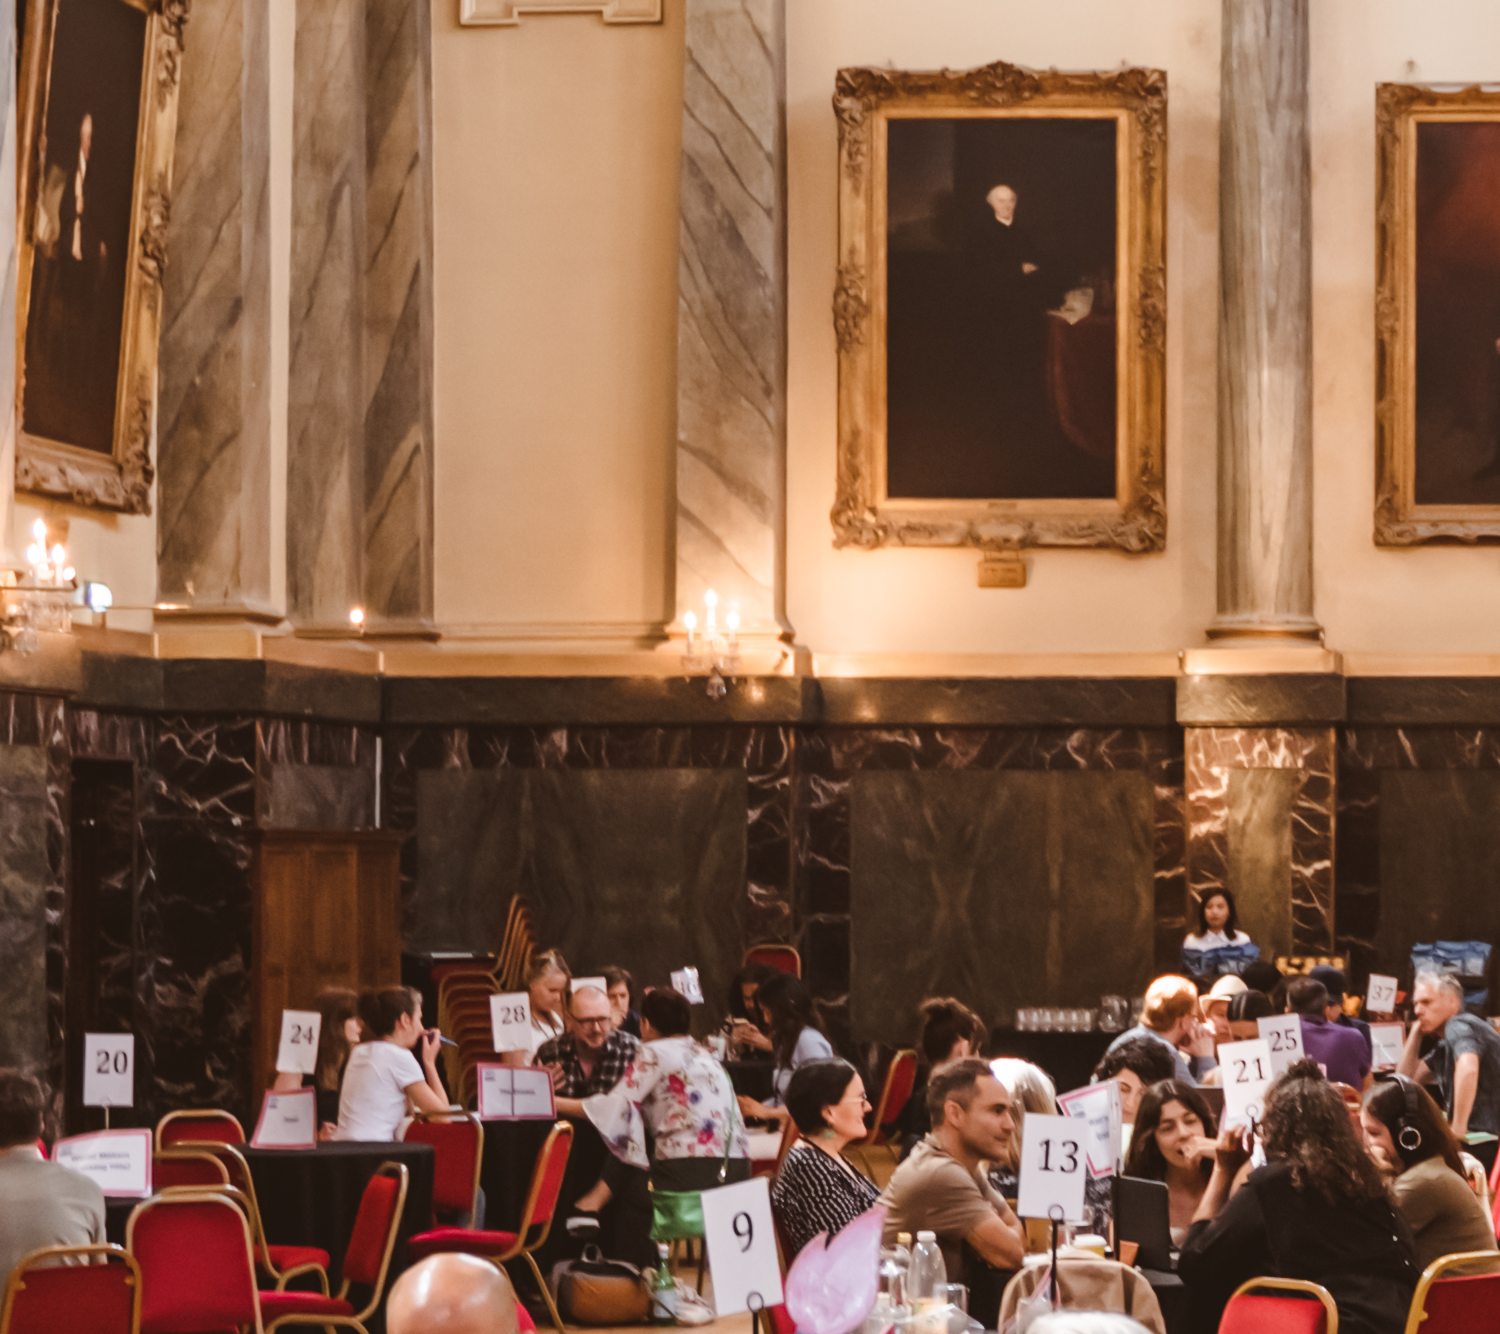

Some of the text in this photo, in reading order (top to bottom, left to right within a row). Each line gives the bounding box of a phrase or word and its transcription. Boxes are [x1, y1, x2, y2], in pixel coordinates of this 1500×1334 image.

[499, 1004, 526, 1025] 28
[290, 1023, 314, 1045] 24
[1268, 1028, 1298, 1053] 25
[95, 1050, 128, 1075] 20
[1232, 1057, 1267, 1084] 21
[1038, 1138, 1080, 1174] 13
[732, 1211, 754, 1254] 9
